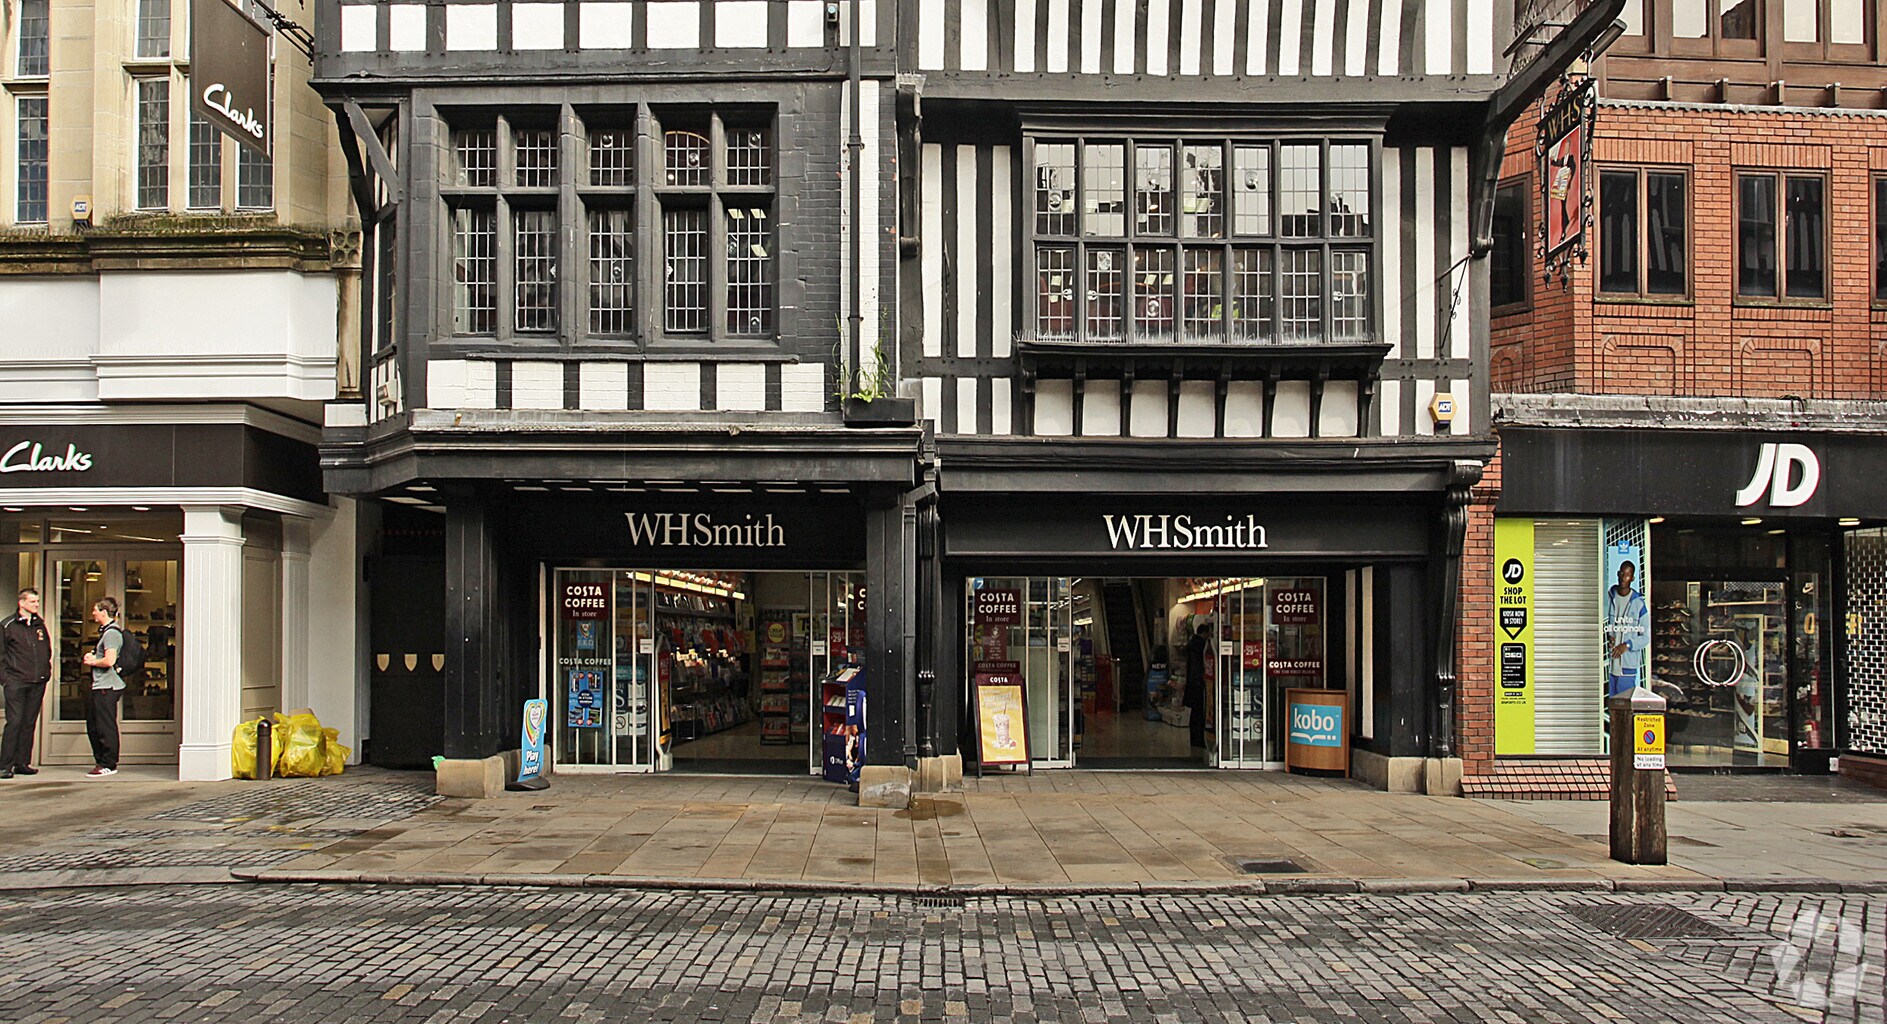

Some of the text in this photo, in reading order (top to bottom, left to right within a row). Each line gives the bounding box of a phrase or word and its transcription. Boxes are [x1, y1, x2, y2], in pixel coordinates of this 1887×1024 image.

[203, 83, 264, 139] Clarks
[0, 440, 93, 473] Clarks
[1735, 443, 1821, 507] JD
[624, 512, 787, 547] WHSmith
[1103, 514, 1268, 549] WHSmith
[1505, 564, 1522, 579] JD
[566, 585, 603, 597] COSTA
[1503, 586, 1523, 596] SHOP
[980, 592, 1014, 603] COSTA
[1277, 592, 1312, 602] COSTA
[1500, 595, 1527, 605] THE LOT
[564, 598, 606, 608] COFFEE
[572, 609, 580, 617] In
[978, 604, 1017, 614] COFFEE
[1275, 604, 1315, 614] COFFEE
[559, 657, 612, 666] COSTA COFFEE
[1269, 661, 1292, 669] COSTA
[1294, 707, 1335, 732] kobo
[526, 750, 540, 763] Play
[523, 762, 540, 776] here!
